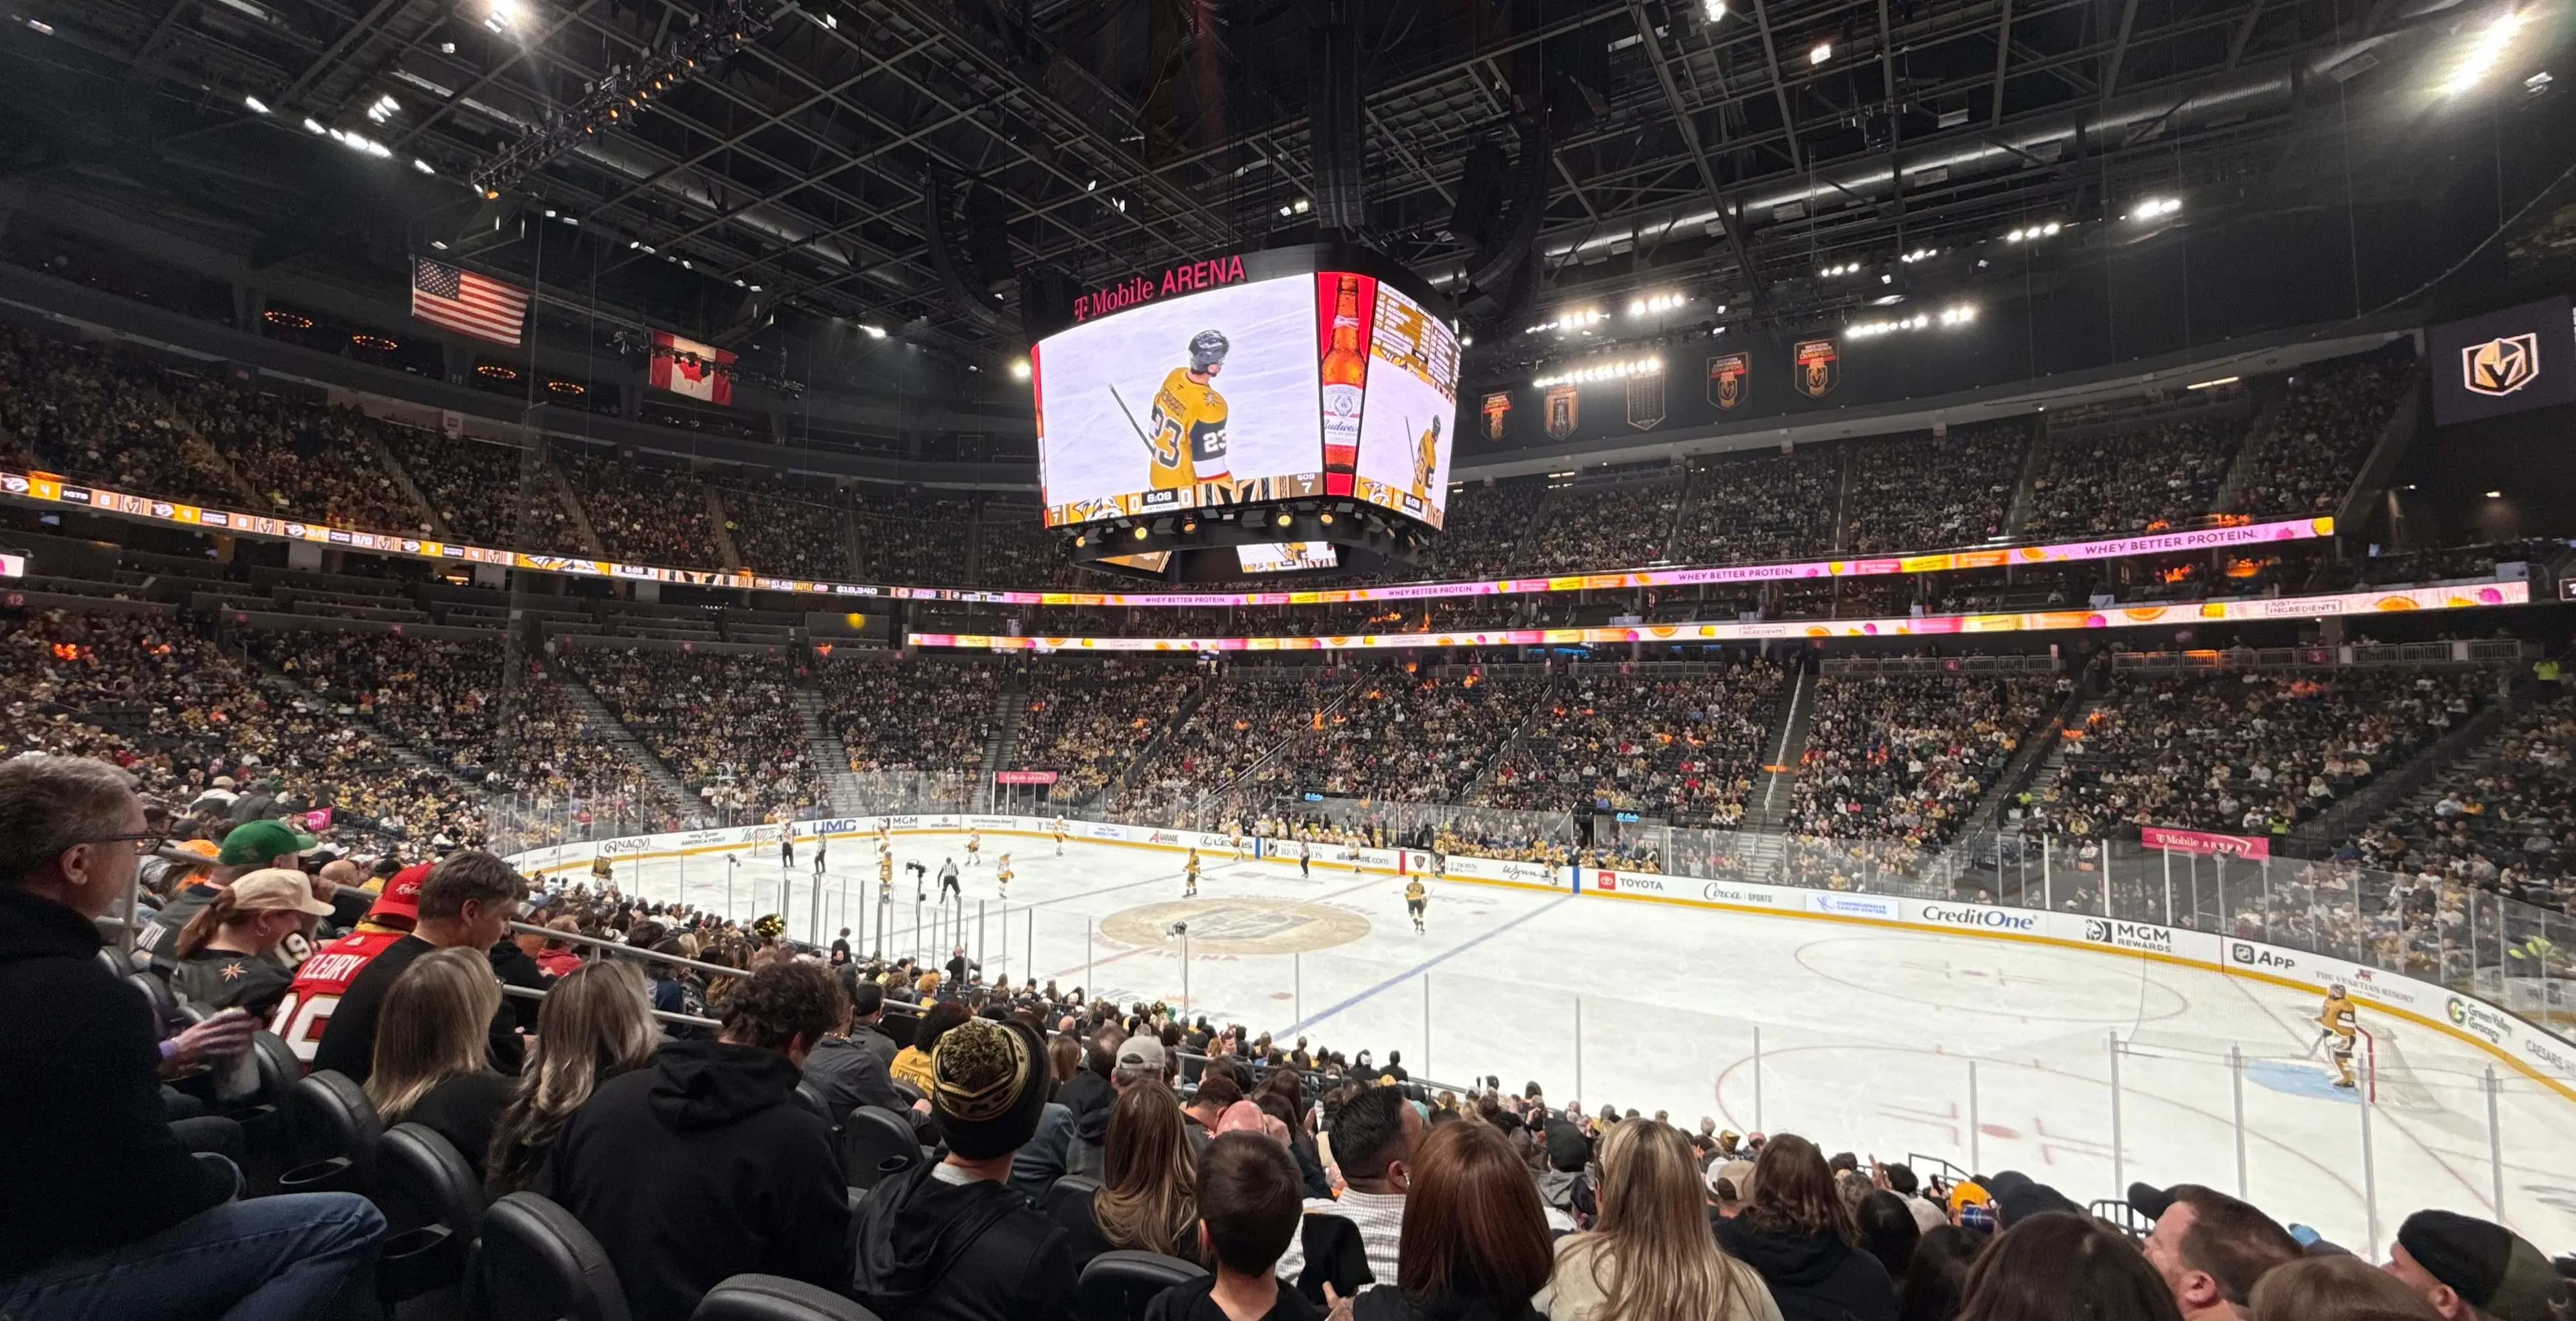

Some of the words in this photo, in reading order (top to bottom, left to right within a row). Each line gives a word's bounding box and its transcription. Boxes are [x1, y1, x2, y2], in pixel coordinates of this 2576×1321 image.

[1092, 277, 1154, 317] Mobile
[1161, 254, 1247, 296] ARENA
[1146, 491, 1171, 503] 6:08
[1181, 488, 1191, 506] 0
[1301, 482, 1312, 494] 7
[1130, 496, 1140, 512] 0
[2086, 542, 2127, 554] WHEY
[2131, 537, 2182, 551] BETTER
[1678, 572, 1707, 580] WHEY
[1710, 570, 1746, 579] BETTER
[1411, 588, 1438, 596] BETTER
[2166, 835, 2199, 848] Mobile
[1619, 878, 1663, 890] TOYOTA
[1704, 882, 1741, 900] Circa
[1748, 893, 1773, 902] SPORTS
[1923, 906, 2034, 930] CreditOne
[2118, 923, 2171, 943] MGM
[2118, 939, 2171, 953] REWARDS
[2257, 951, 2295, 969] App
[2316, 971, 2334, 981] THE
[2336, 976, 2380, 994] VENETIAN
[2382, 988, 2415, 1004] RESORT
[2468, 1004, 2491, 1023] Green
[2468, 1017, 2500, 1041] Grocery
[2526, 1039, 2563, 1071] CAESARS
